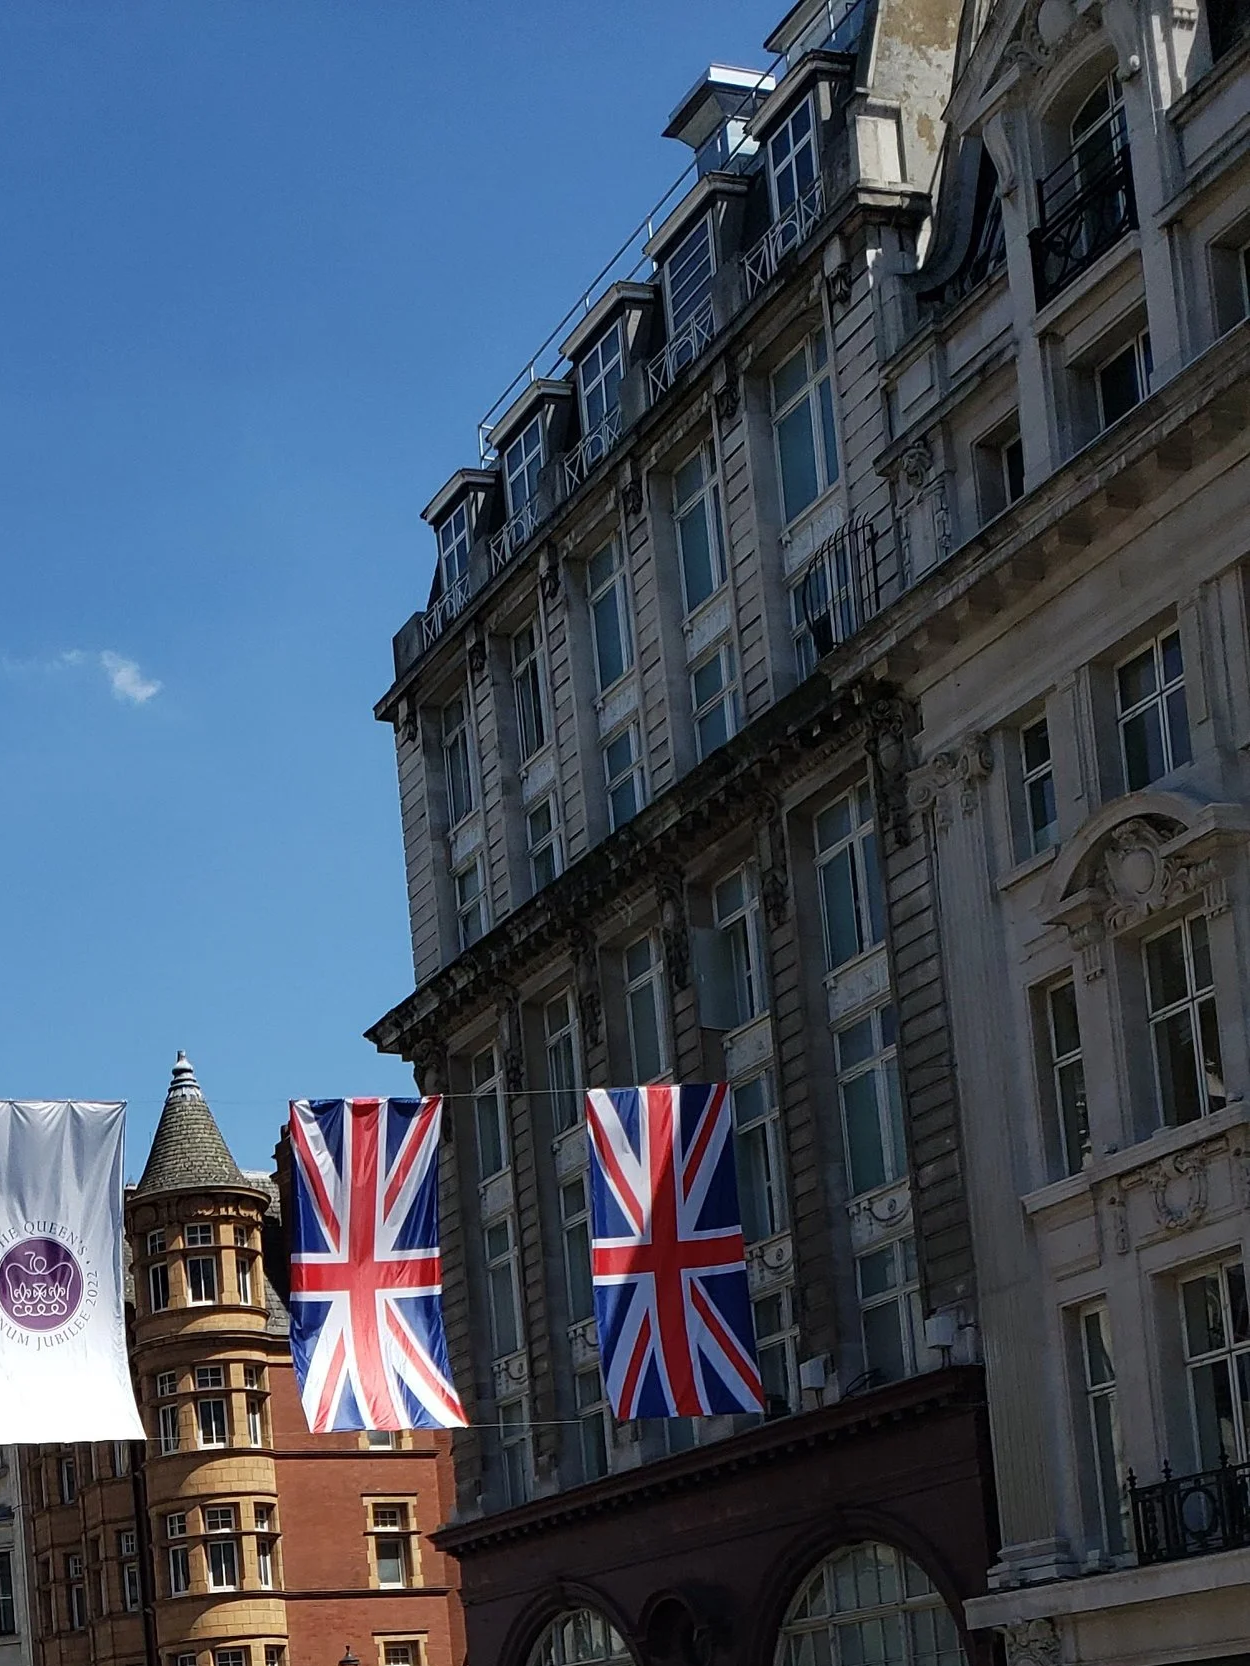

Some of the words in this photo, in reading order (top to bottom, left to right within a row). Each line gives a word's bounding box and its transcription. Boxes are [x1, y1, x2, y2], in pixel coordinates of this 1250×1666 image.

[24, 1220, 88, 1256] QUEEN'S
[37, 1310, 91, 1351] JUBILEE
[85, 1270, 99, 1307] 2022
